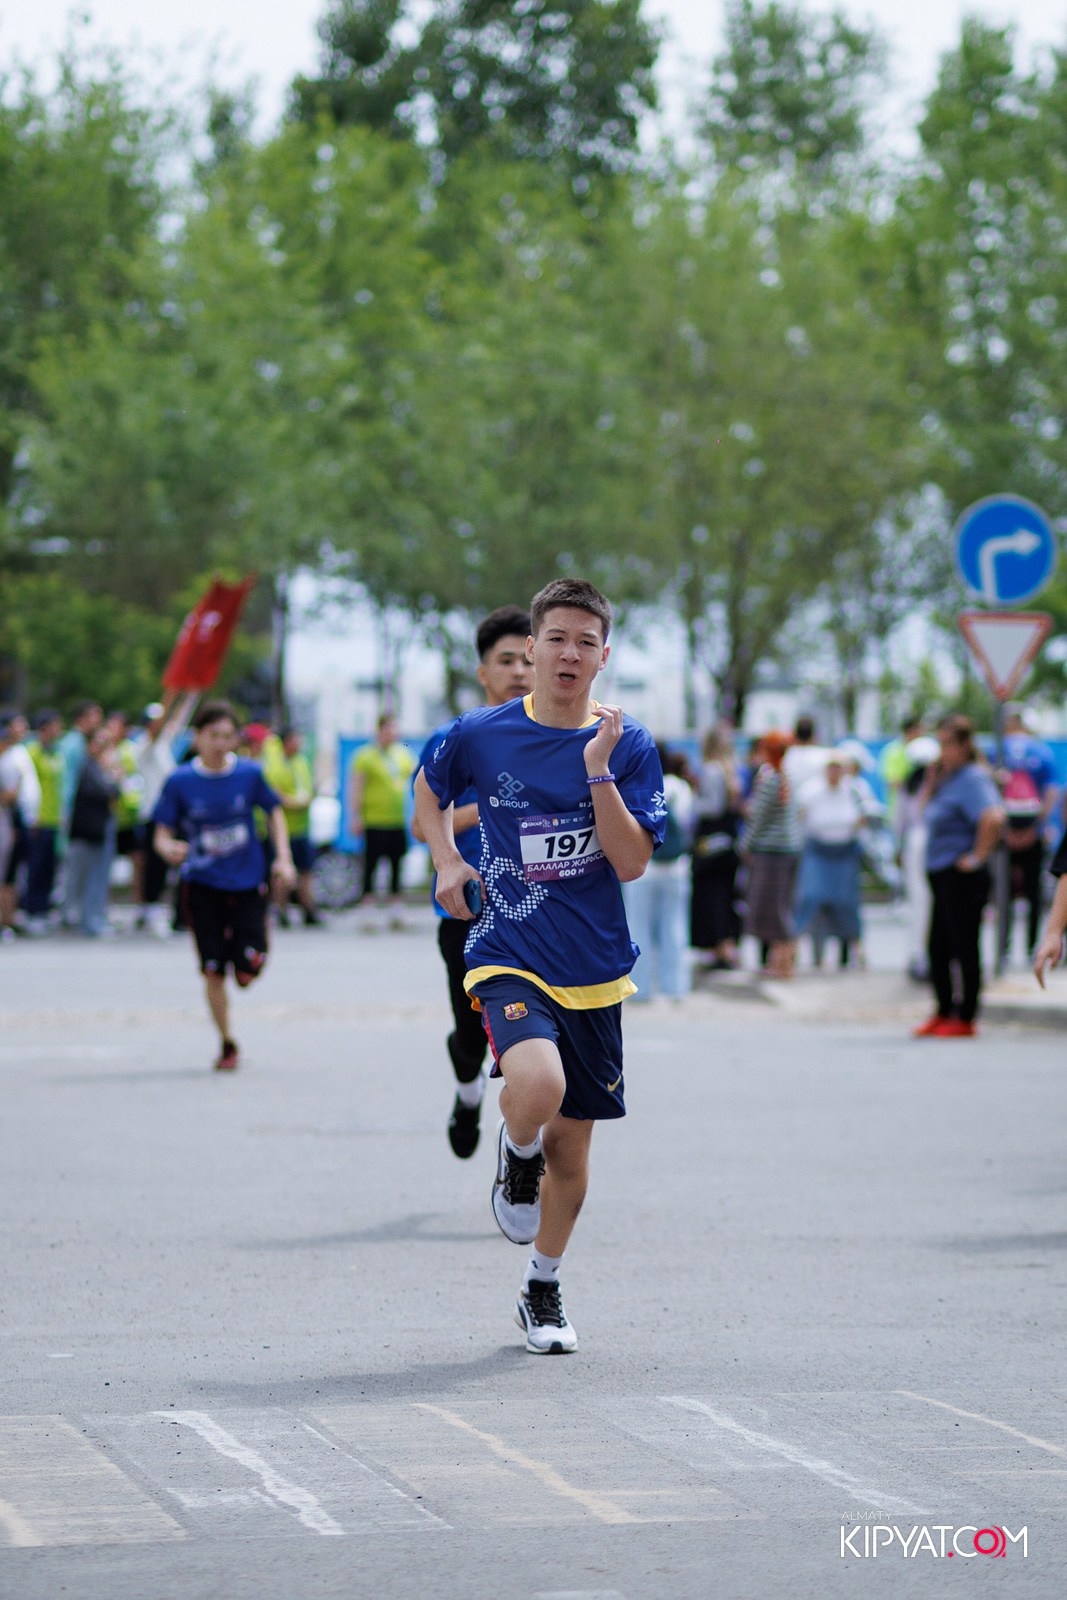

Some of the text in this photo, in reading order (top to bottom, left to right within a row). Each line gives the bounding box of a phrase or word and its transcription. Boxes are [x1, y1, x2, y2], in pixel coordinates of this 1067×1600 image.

[501, 800, 529, 809] GROUP
[545, 829, 593, 859] 197
[527, 861, 570, 872] БАЛАЛАР
[559, 868, 577, 878] 600
